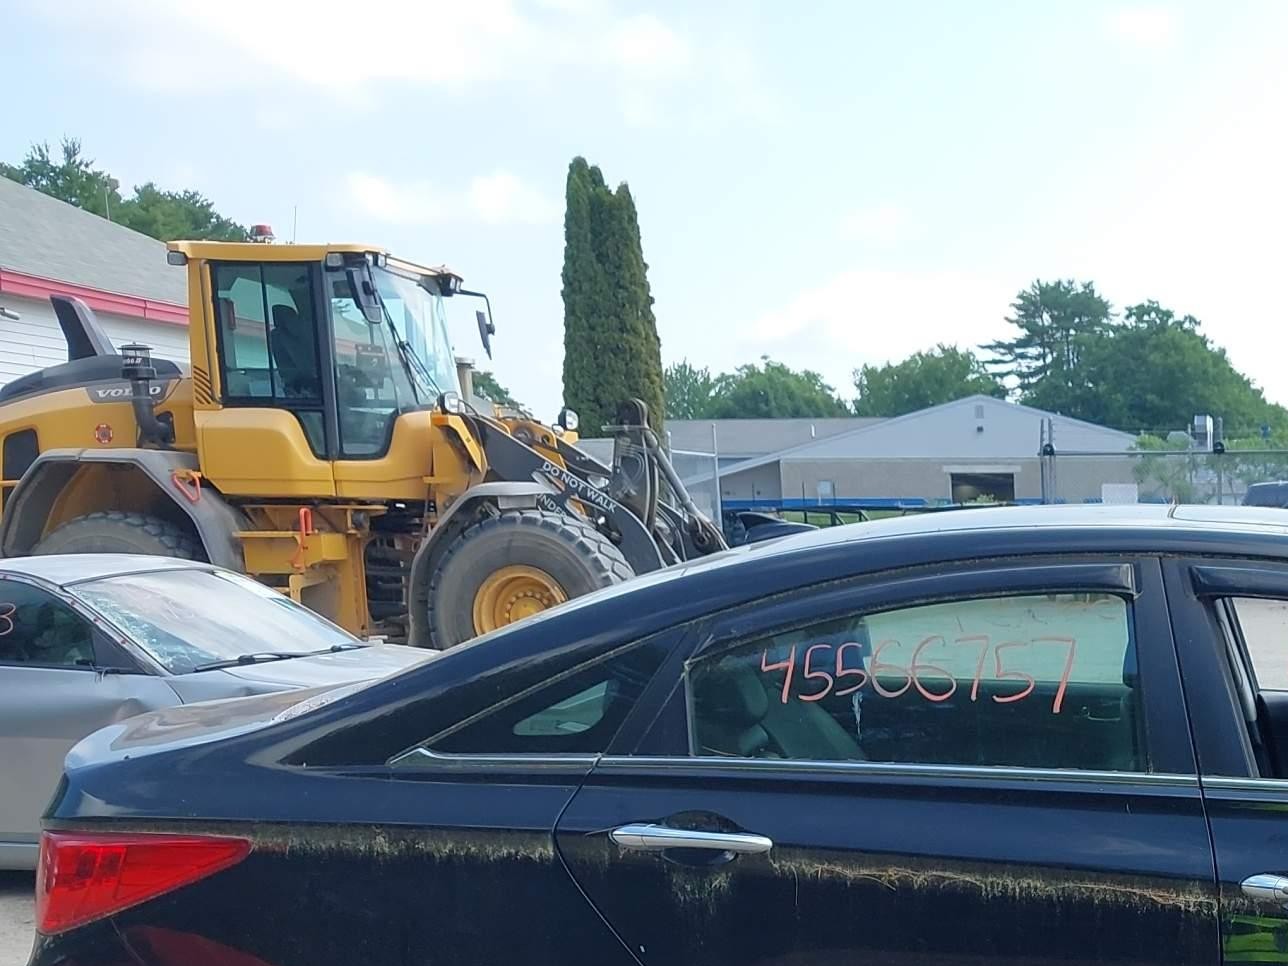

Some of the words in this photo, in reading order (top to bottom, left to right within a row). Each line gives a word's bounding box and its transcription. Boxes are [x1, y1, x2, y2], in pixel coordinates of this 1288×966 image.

[96, 386, 161, 398] VOLO
[536, 493, 569, 521] NDER
[542, 461, 560, 476] DO
[561, 473, 586, 492] NOT
[586, 488, 617, 513] WALK
[761, 635, 1076, 714] 45566757
